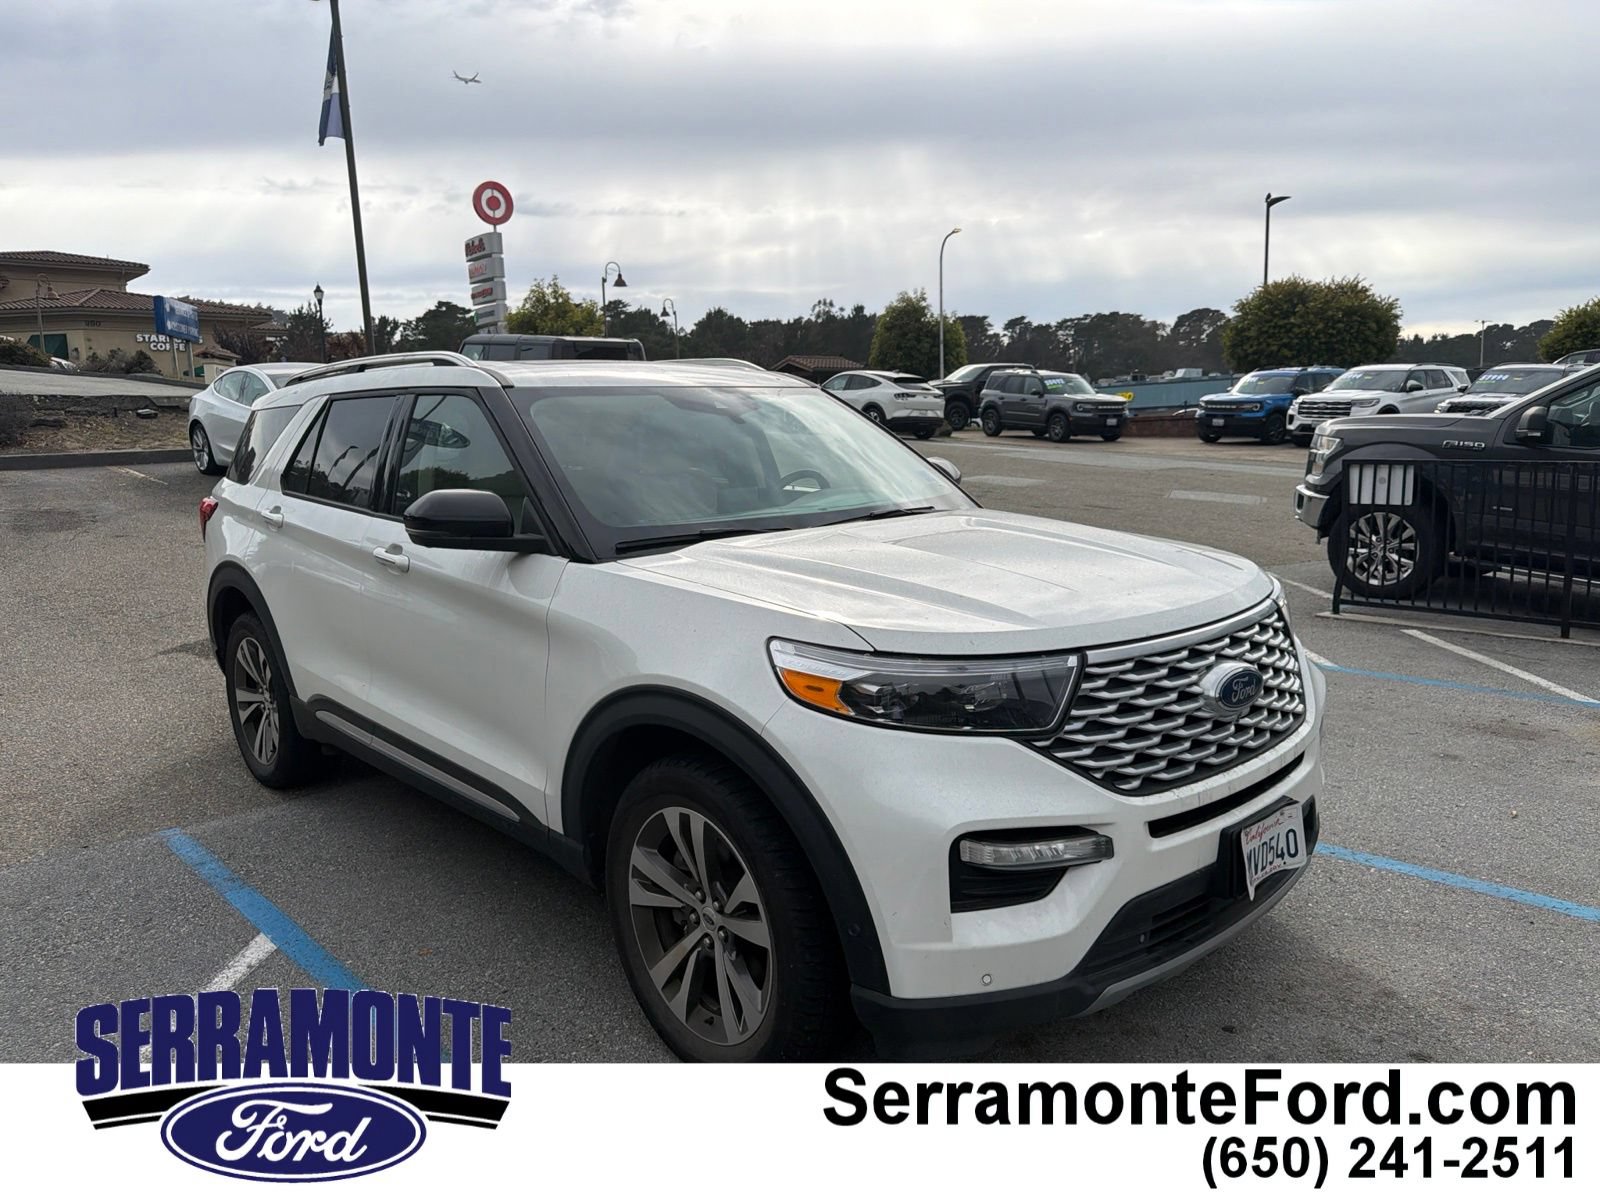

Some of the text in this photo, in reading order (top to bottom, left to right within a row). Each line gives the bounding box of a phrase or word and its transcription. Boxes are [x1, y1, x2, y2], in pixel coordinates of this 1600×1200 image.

[136, 333, 203, 344] STARS
[150, 342, 186, 351] COFFE
[1232, 676, 1258, 703] Ford
[1246, 817, 1284, 846] California
